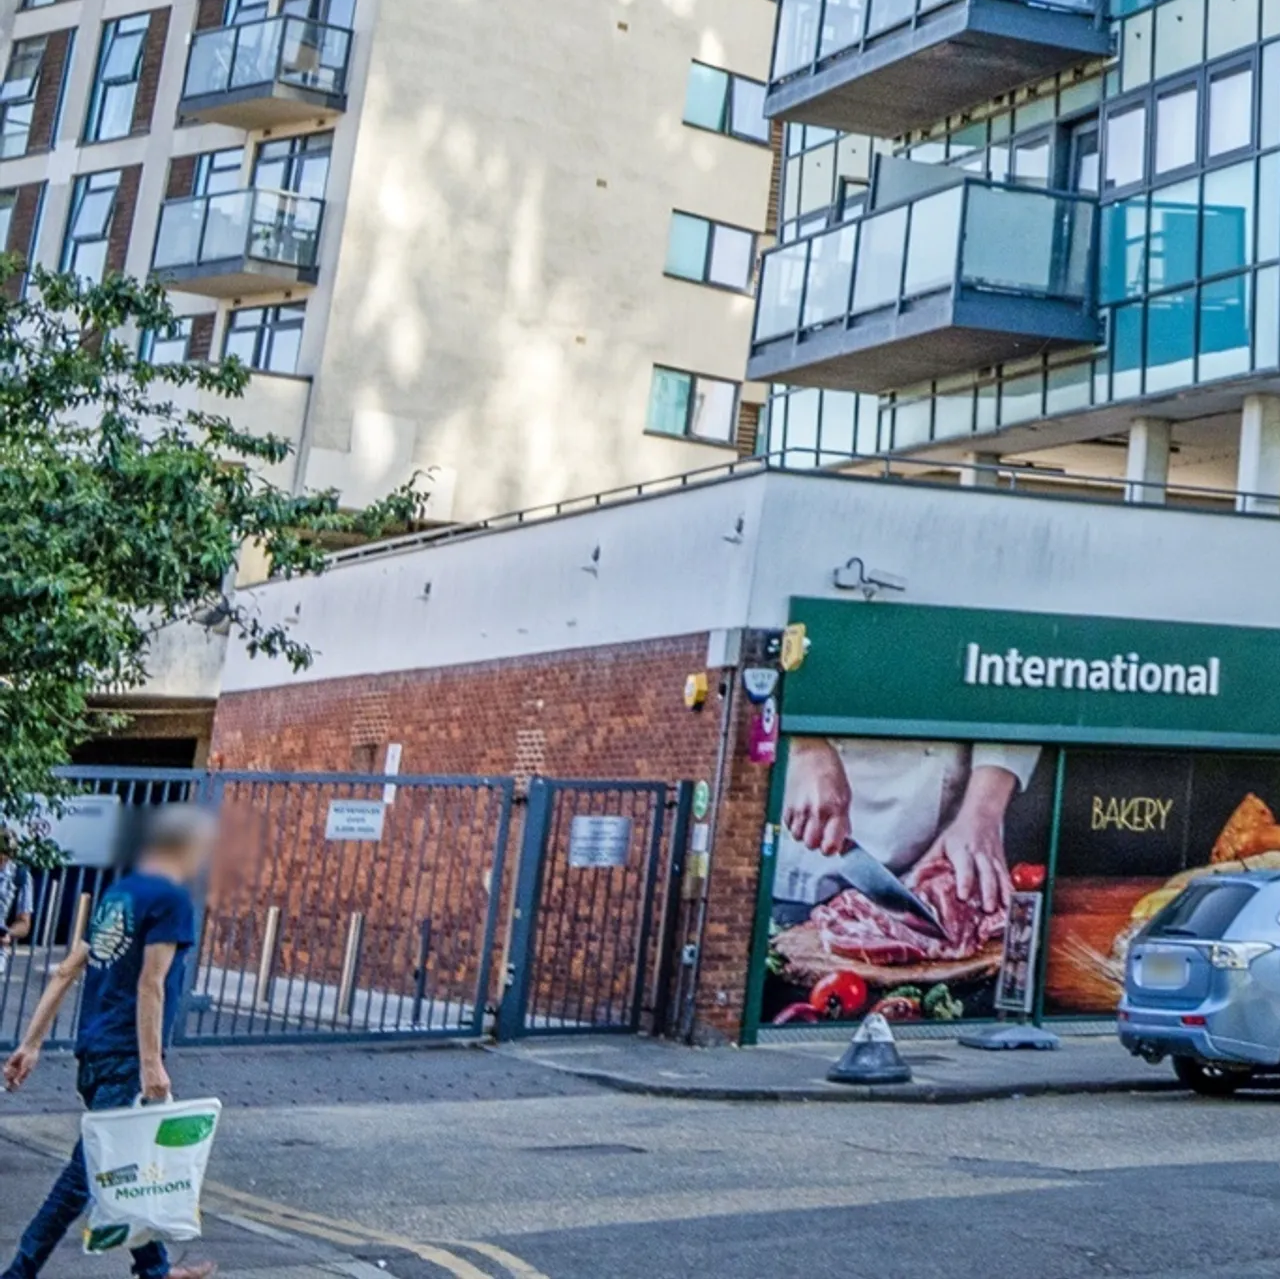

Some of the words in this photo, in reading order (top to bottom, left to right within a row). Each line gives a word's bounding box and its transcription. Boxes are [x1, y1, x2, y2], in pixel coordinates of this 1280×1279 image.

[964, 642, 1219, 696] International
[1091, 796, 1173, 831] BAKERY
[115, 1179, 192, 1200] Morrisons
